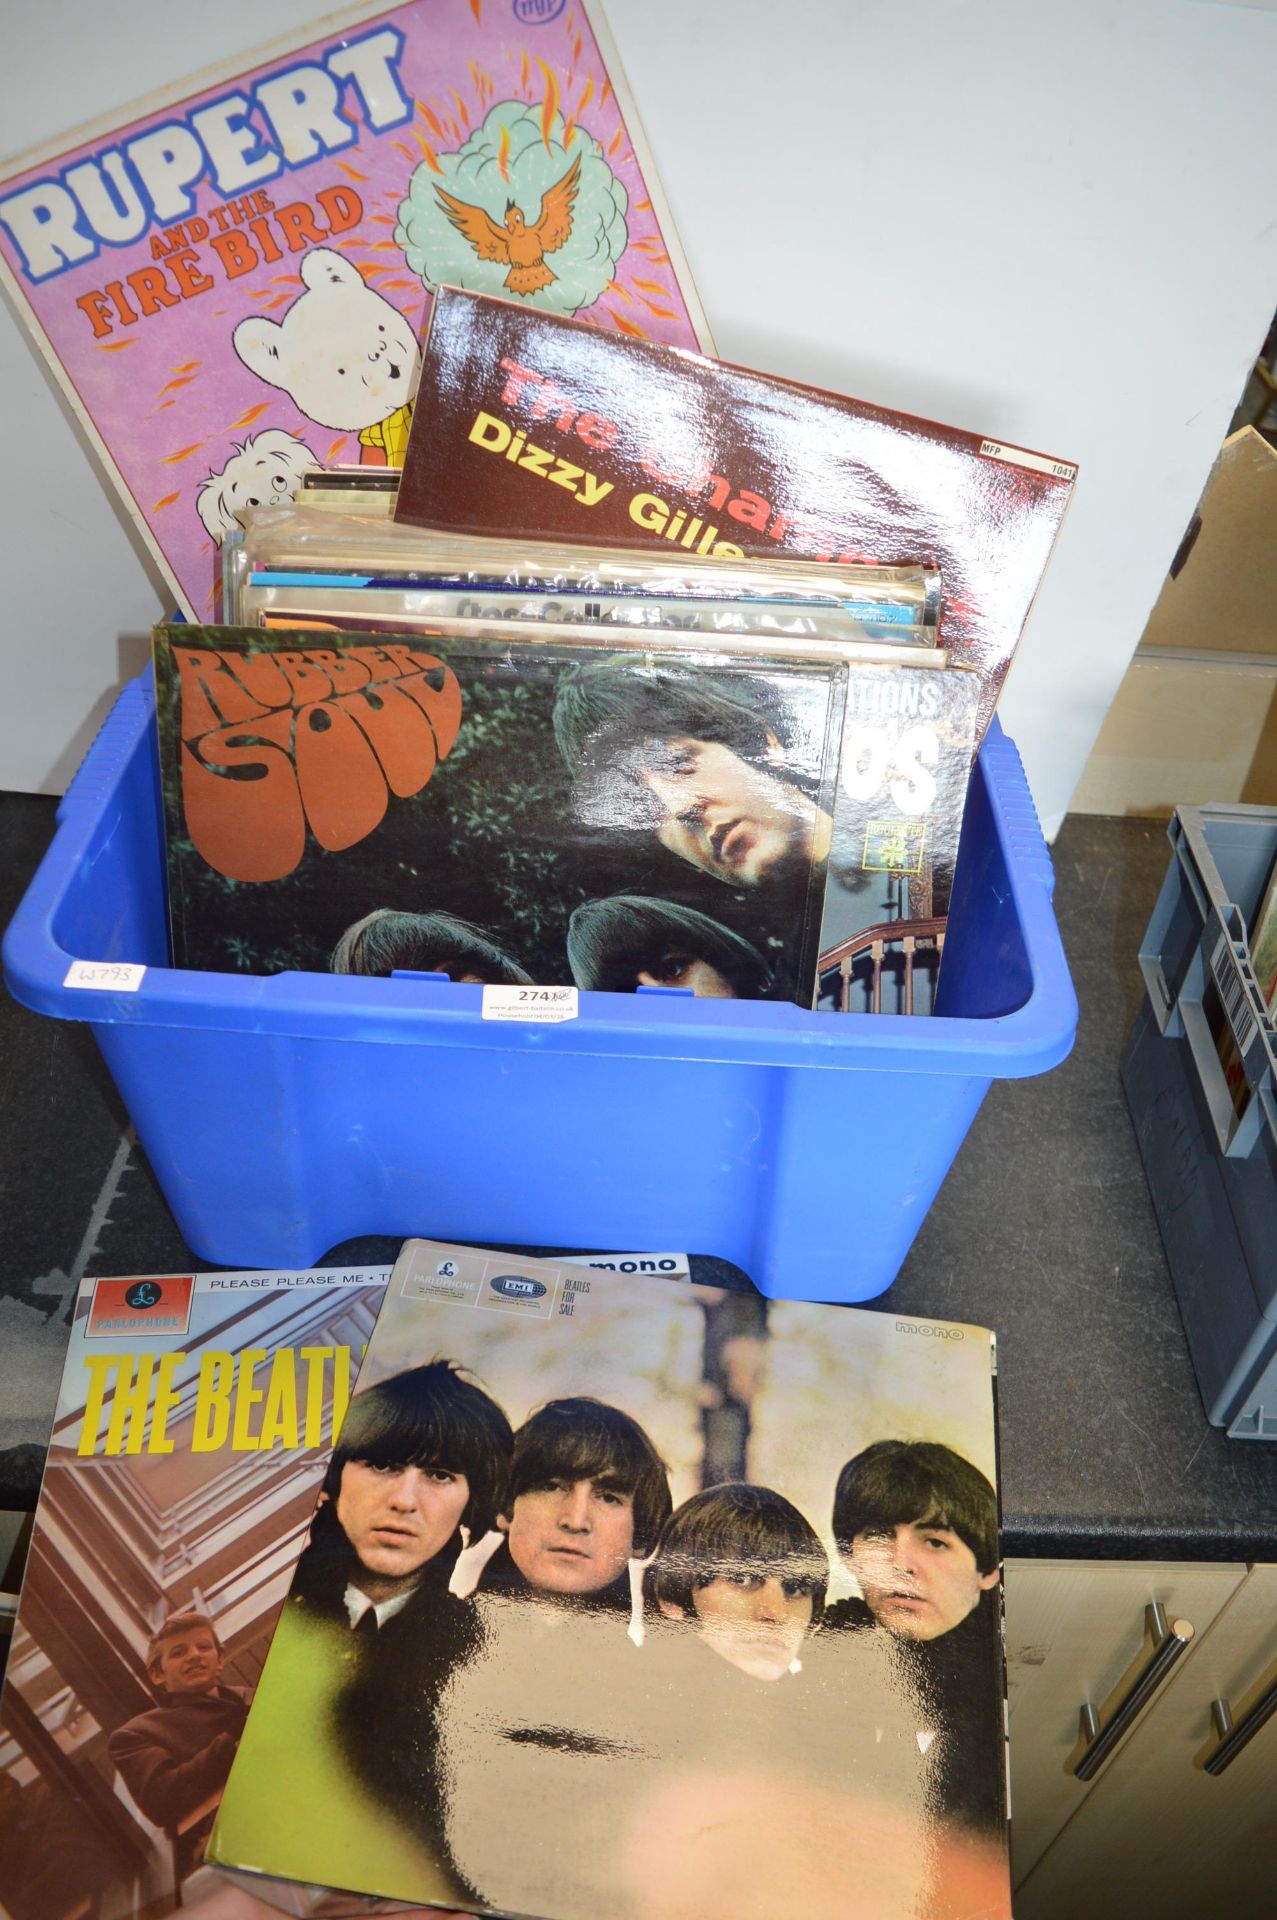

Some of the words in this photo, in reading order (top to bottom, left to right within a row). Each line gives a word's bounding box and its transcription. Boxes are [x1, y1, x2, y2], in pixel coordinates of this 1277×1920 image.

[0, 22, 414, 285] RUPERT
[149, 217, 210, 260] AND
[208, 189, 275, 231] THE
[76, 248, 214, 339] FIRE
[210, 185, 363, 280] BIRD
[500, 357, 618, 451] The
[981, 443, 1001, 456] MFP
[1052, 464, 1073, 478] 1041
[468, 411, 615, 506] Dizzy
[629, 492, 760, 561] Gille
[589, 1259, 677, 1273] mono
[210, 1279, 271, 1289] PLEASE
[276, 1277, 337, 1286] PLEASE
[342, 1275, 364, 1283] ME
[413, 1273, 477, 1291] PARLOPHONE
[507, 1283, 529, 1291] EMI
[564, 1279, 591, 1293] BEATLES
[561, 1291, 575, 1304] FOR
[558, 1303, 575, 1316] SALE
[97, 1316, 179, 1329] PARLOPHONE
[895, 1321, 965, 1340] mono
[77, 1352, 186, 1456] THE
[191, 1344, 367, 1453] BEATL
